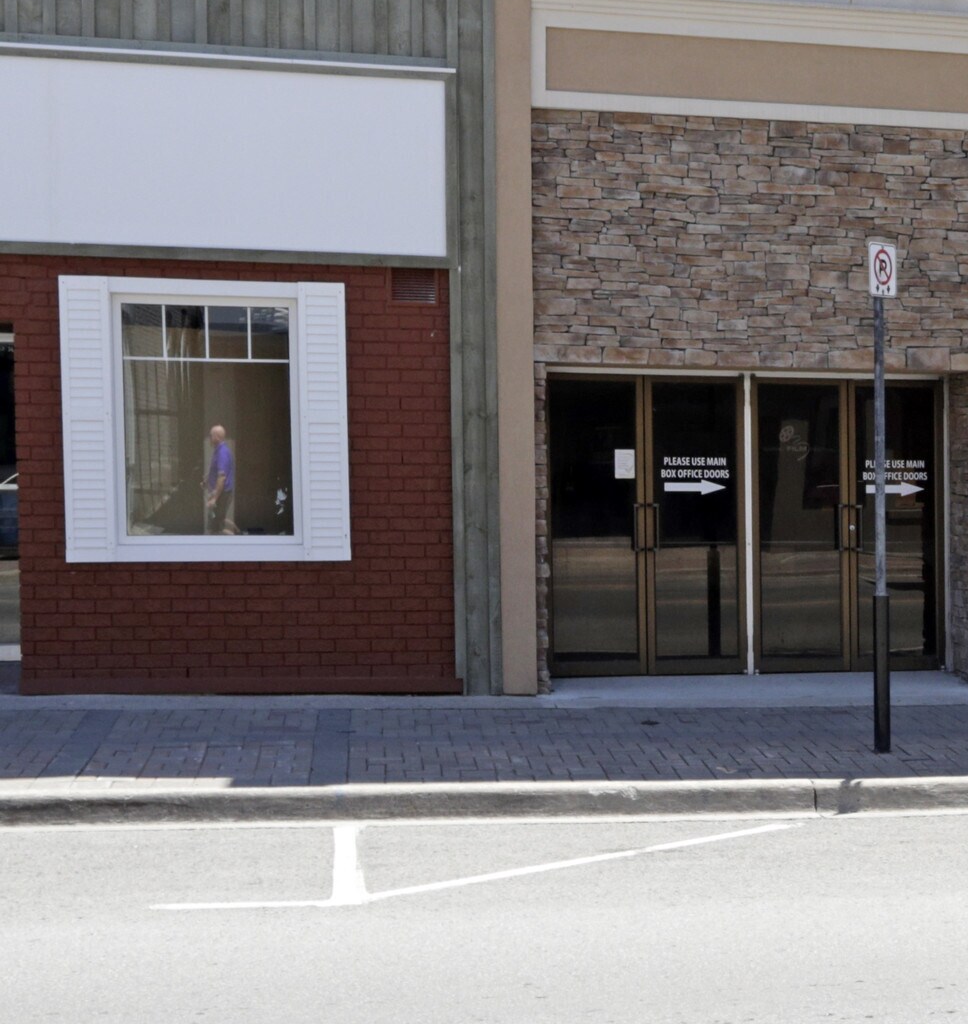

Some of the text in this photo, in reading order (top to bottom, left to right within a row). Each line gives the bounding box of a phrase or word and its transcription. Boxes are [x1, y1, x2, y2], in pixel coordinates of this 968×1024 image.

[663, 457, 727, 466] PLEASE USE MAIN
[891, 460, 905, 468] USE
[906, 460, 925, 468] MAIN
[661, 469, 729, 478] BOX OFFICE DOORS
[883, 472, 903, 480] FFICE
[903, 472, 928, 481] DOORS
